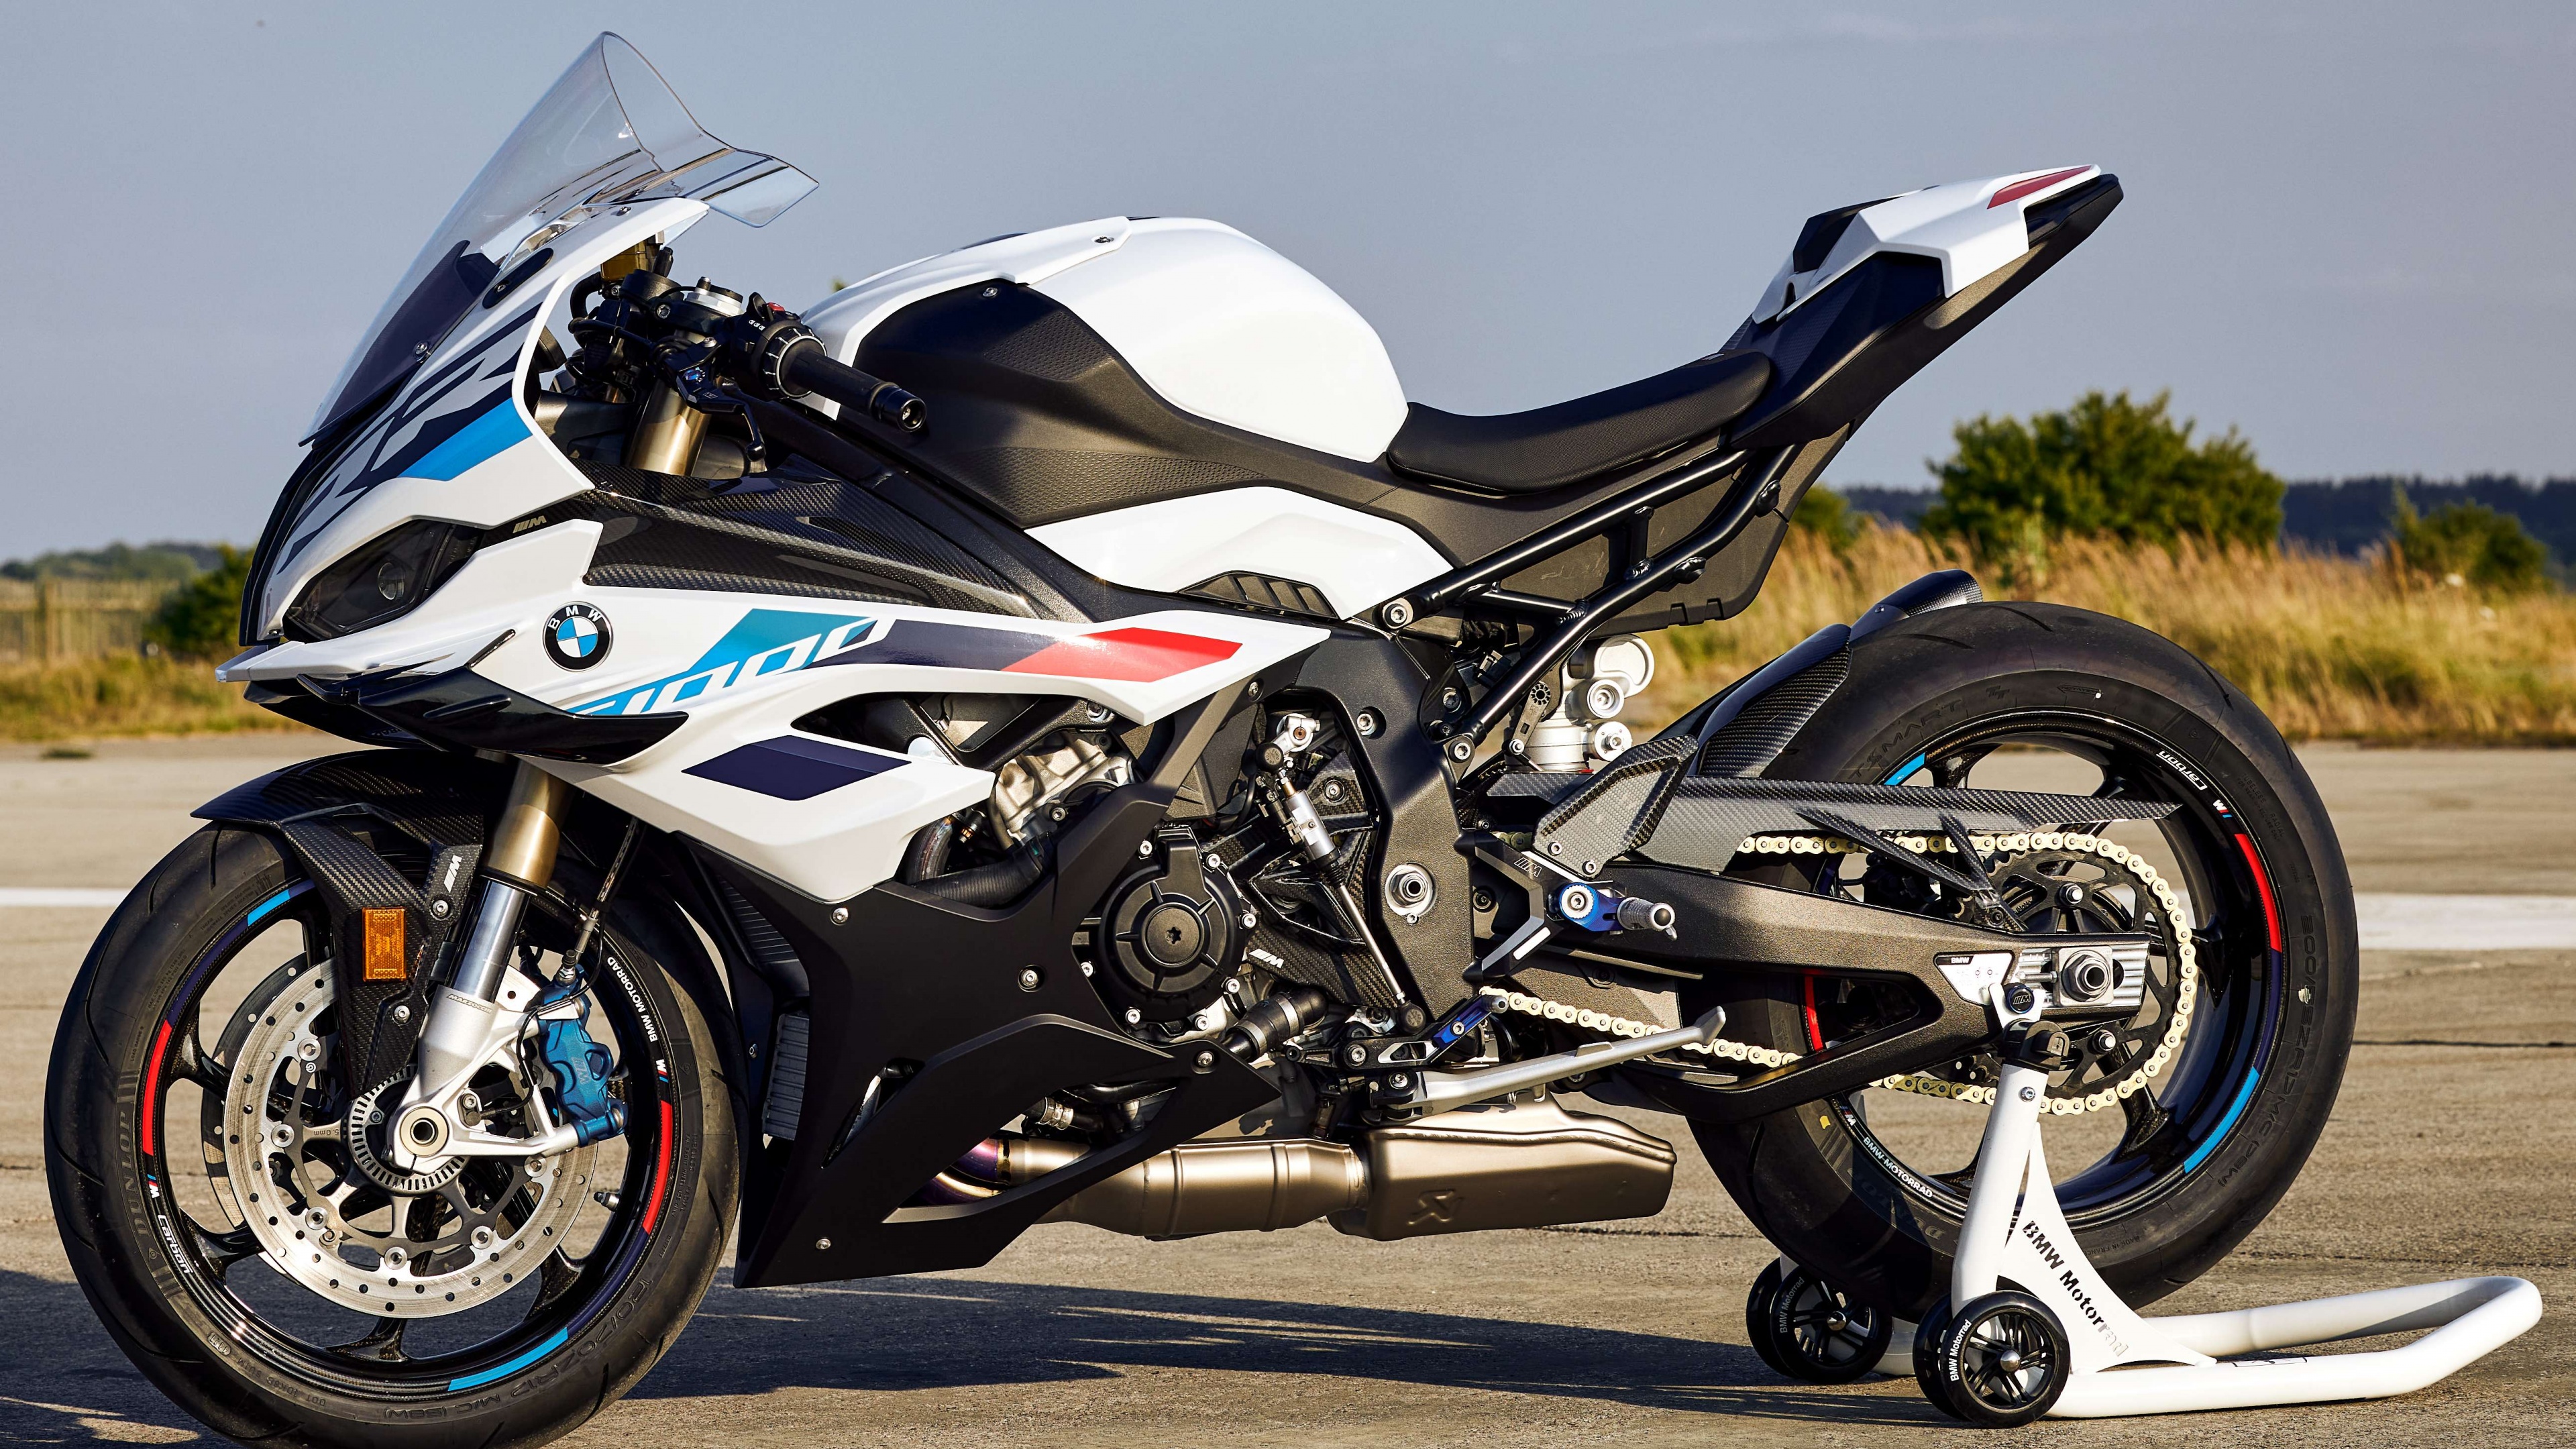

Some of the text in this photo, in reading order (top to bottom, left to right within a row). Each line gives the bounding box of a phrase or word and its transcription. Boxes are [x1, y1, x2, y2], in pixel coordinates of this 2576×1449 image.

[548, 605, 603, 631] BMW
[2155, 751, 2208, 791] Carbon
[2269, 811, 2286, 837] RADIAL
[446, 993, 492, 1014] MARZOCCHI
[607, 957, 658, 1042] BMW MOTORRAD
[118, 1110, 152, 1240] DUNLOP
[1863, 1136, 1933, 1197] BMW MOTORRAD
[679, 1185, 692, 1213] RADIAL
[158, 1214, 193, 1273] Carbon
[2023, 1220, 2064, 1270] BMW
[1779, 1277, 1805, 1334] BMW Motorrad
[507, 1274, 654, 1399] 120/70ZR17
[1948, 1319, 1972, 1381] BMW Motorrad
[304, 1393, 327, 1408] DOT
[453, 1393, 501, 1415] M/C
